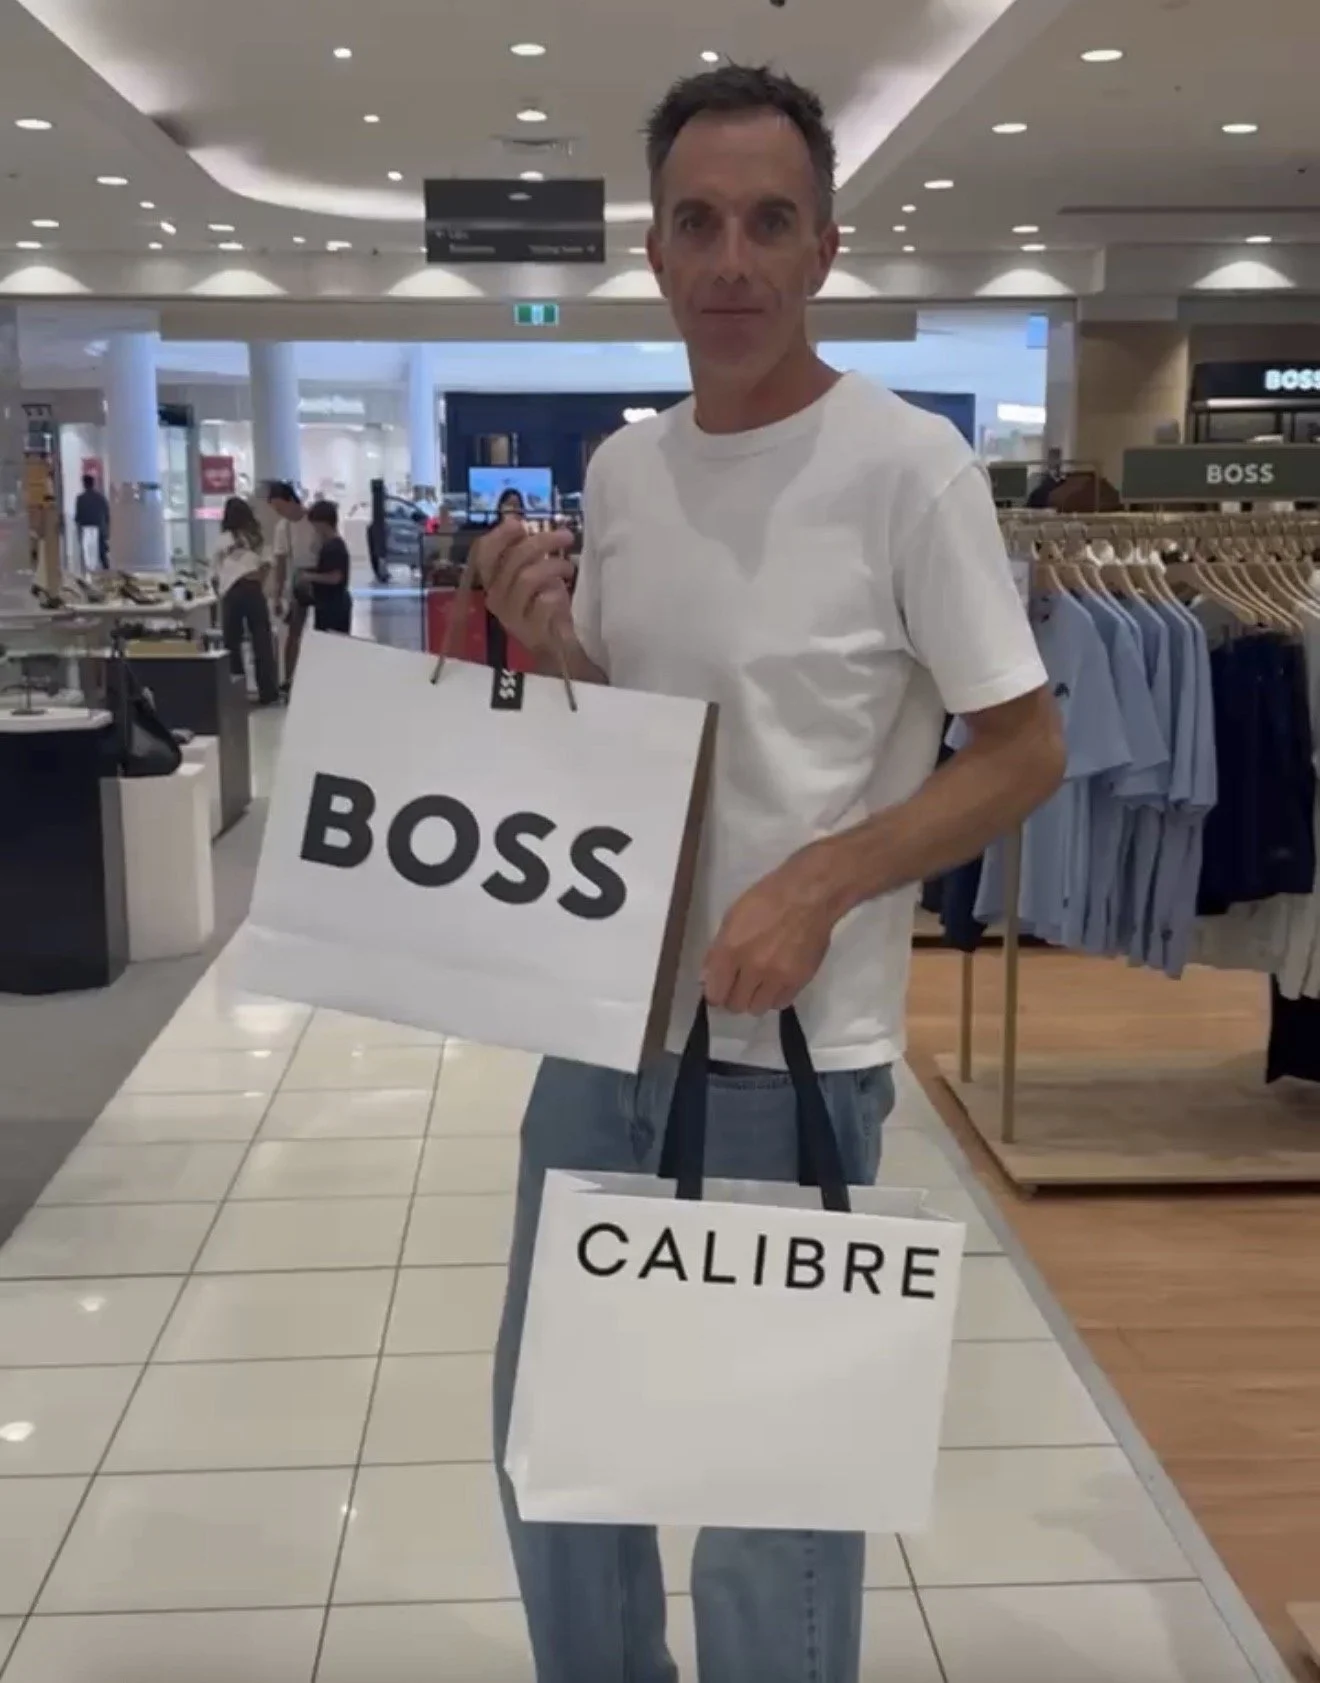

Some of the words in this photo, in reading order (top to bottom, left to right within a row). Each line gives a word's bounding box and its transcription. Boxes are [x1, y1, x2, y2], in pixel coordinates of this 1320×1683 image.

[1206, 463, 1275, 484] BOSS
[300, 773, 632, 919] BOSS
[577, 1222, 940, 1299] CALIBRE
